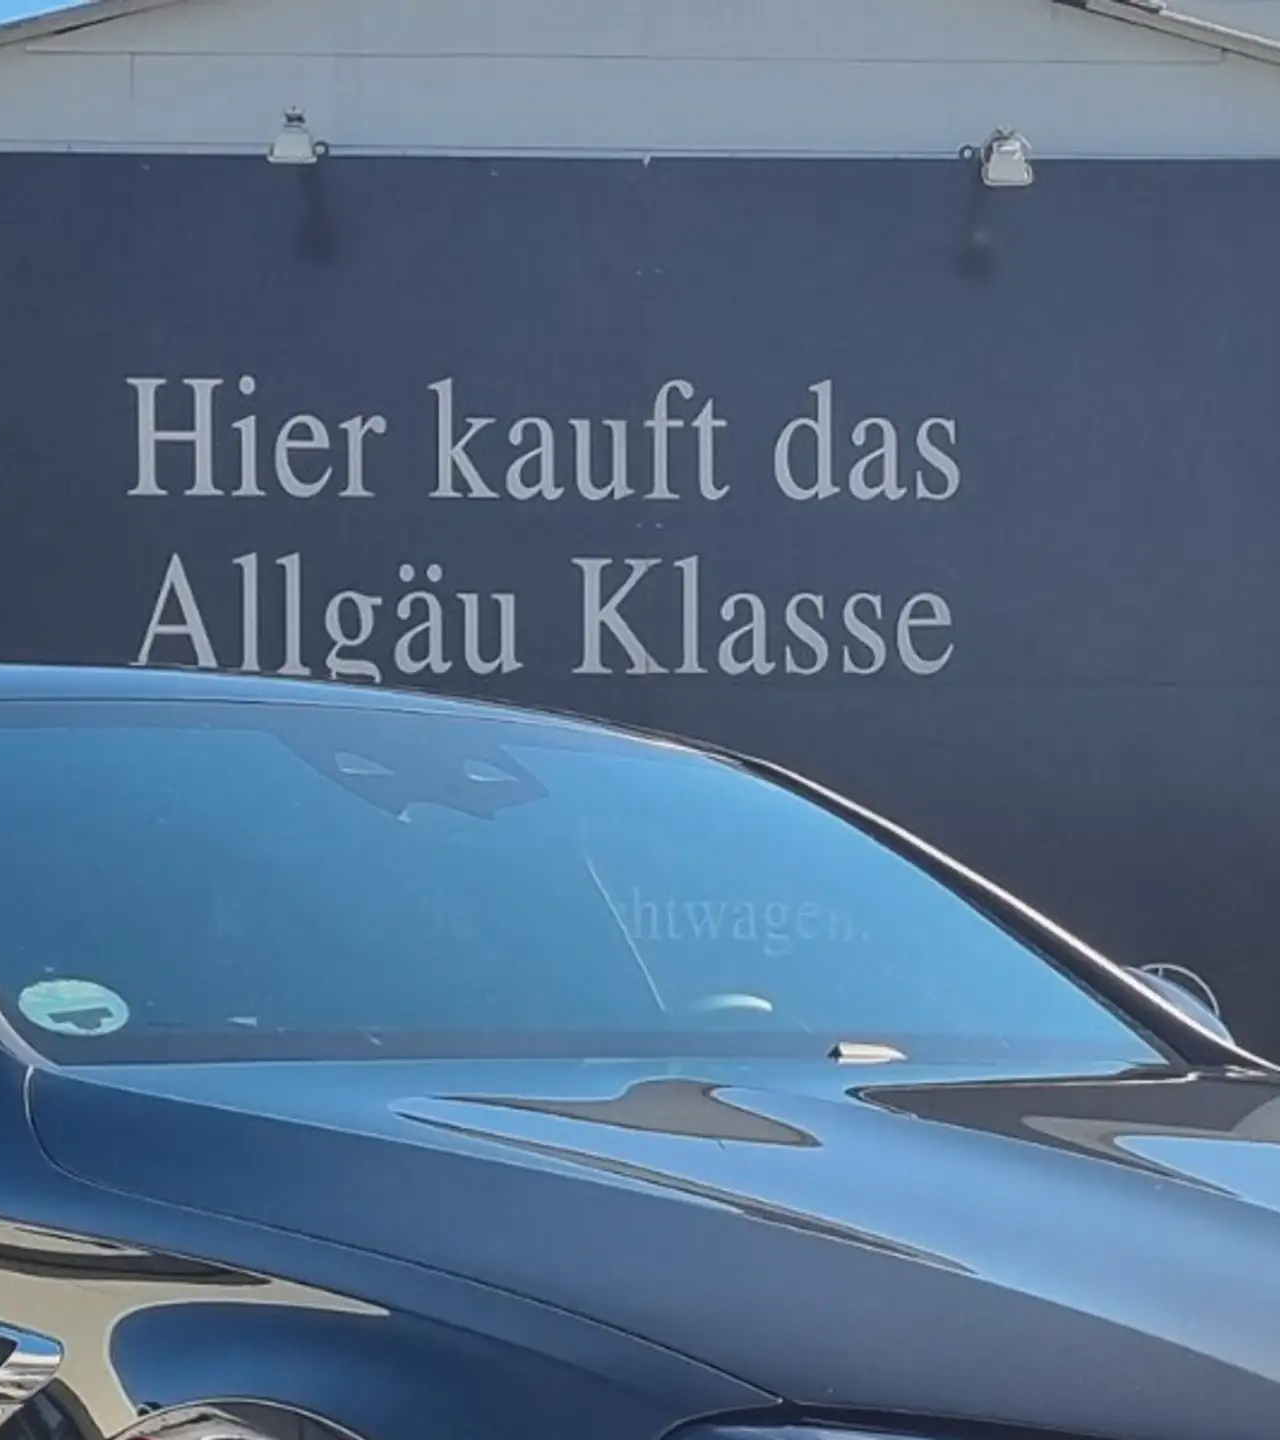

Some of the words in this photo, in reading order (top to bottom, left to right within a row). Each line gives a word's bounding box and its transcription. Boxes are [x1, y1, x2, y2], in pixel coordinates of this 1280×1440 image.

[126, 375, 387, 497] Hier
[427, 377, 730, 500] kauft
[773, 379, 960, 500] das
[129, 552, 523, 682] Allgäu
[571, 554, 955, 675] Klasse
